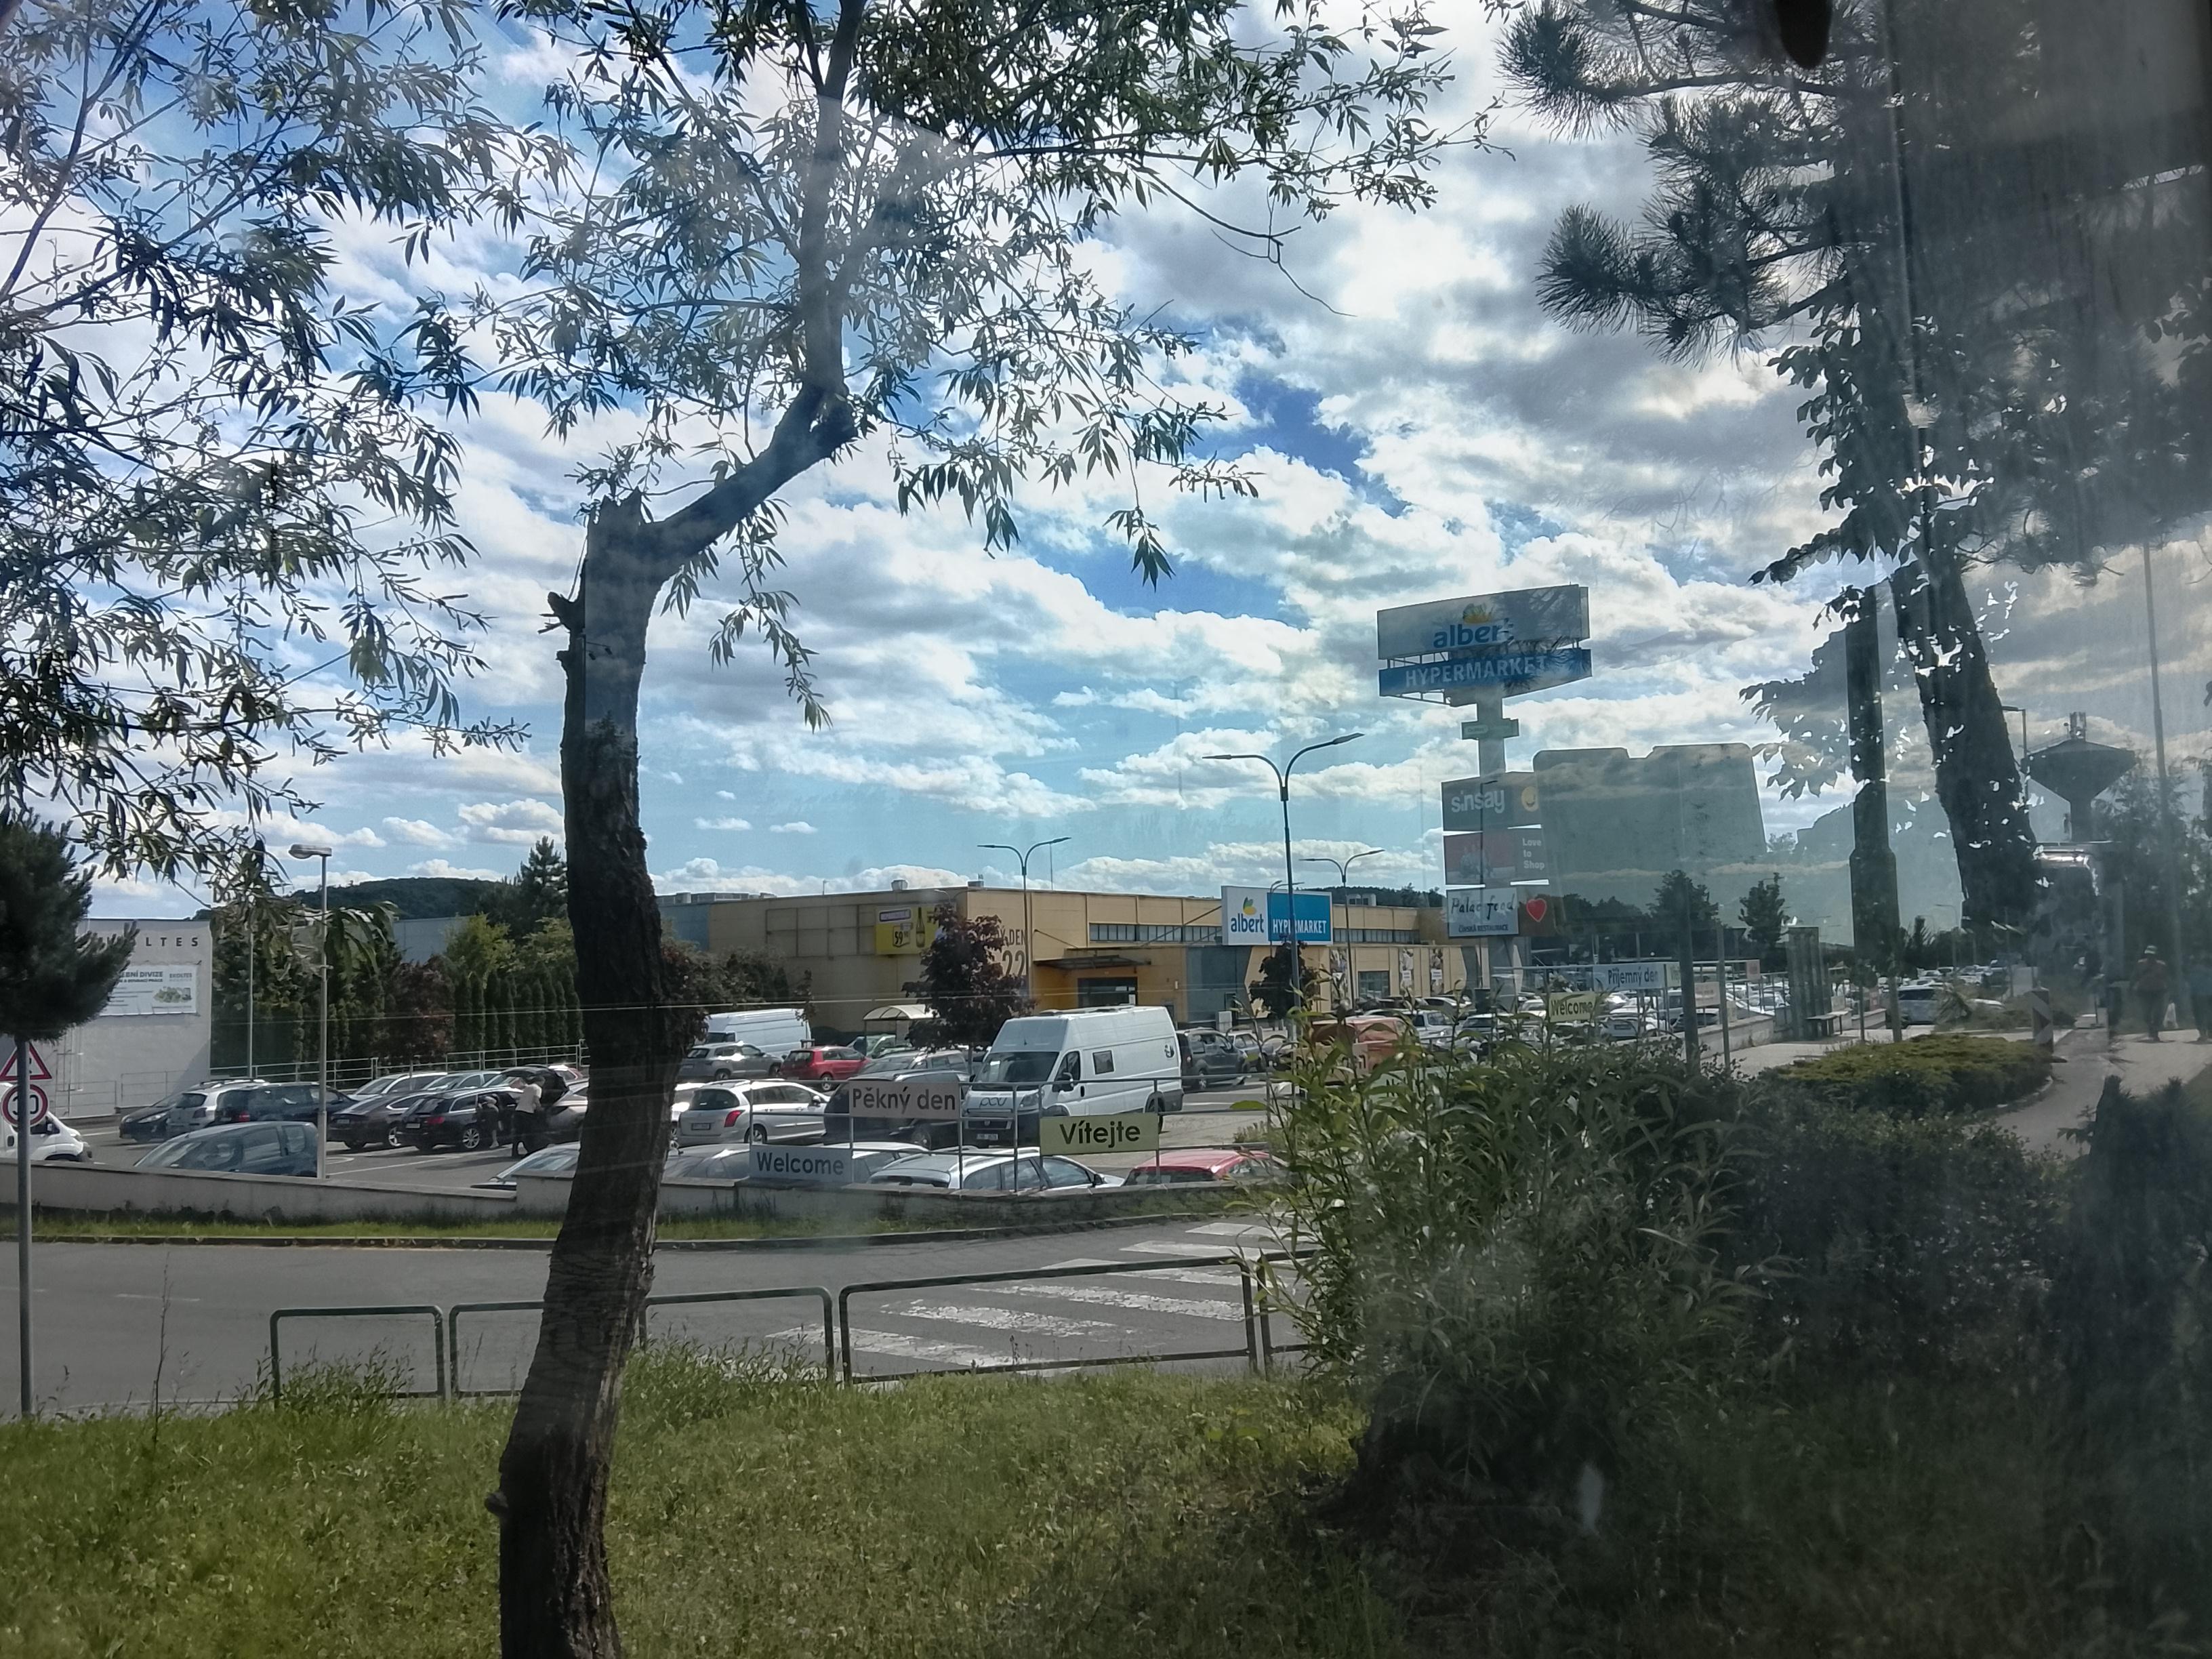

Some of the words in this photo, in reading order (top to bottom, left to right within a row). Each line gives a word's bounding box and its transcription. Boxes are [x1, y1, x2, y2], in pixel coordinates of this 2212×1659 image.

[1433, 618, 1511, 649] alber
[1406, 656, 1548, 687] HYPERMARKET
[1451, 790, 1505, 814] sinsay
[1522, 838, 1542, 846] Love
[1523, 849, 1532, 857] to
[1523, 860, 1545, 870] Shop
[1231, 913, 1265, 933] albert
[1273, 918, 1327, 934] HYPMARKET
[146, 937, 199, 947] LTES
[895, 930, 903, 945] 59
[1644, 968, 1658, 983] den
[1551, 1000, 1593, 1016] Welcome
[853, 1087, 911, 1115] Pěkný
[917, 1088, 956, 1111] den
[1059, 1120, 1141, 1149] Vítejte
[756, 1152, 844, 1175] Welcome
